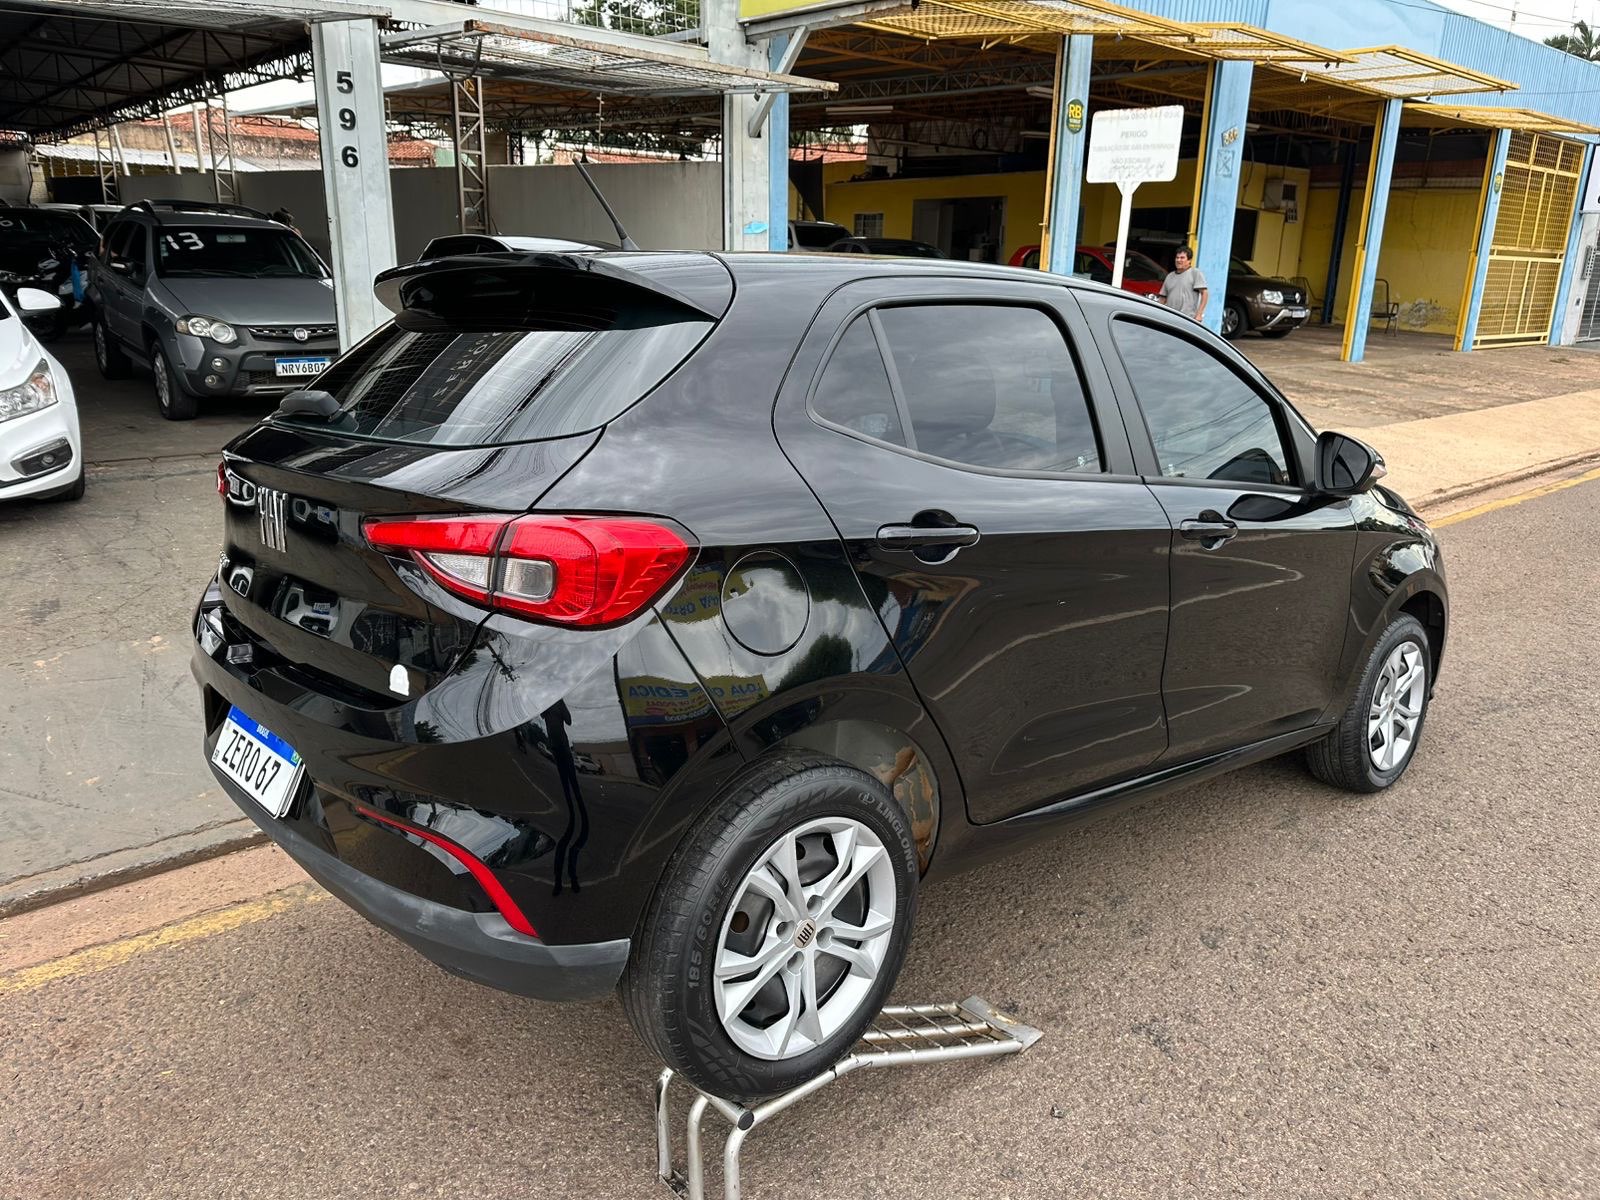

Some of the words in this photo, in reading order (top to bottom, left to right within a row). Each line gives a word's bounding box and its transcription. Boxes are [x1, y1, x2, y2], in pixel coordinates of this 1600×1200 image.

[336, 70, 359, 168] 596
[1068, 103, 1082, 119] RB
[166, 231, 204, 250] 13
[257, 485, 288, 553] FIAT
[221, 728, 261, 783] ZERO
[254, 755, 282, 796] 67
[875, 801, 917, 873] LINGLONG
[796, 922, 816, 946] FIAT
